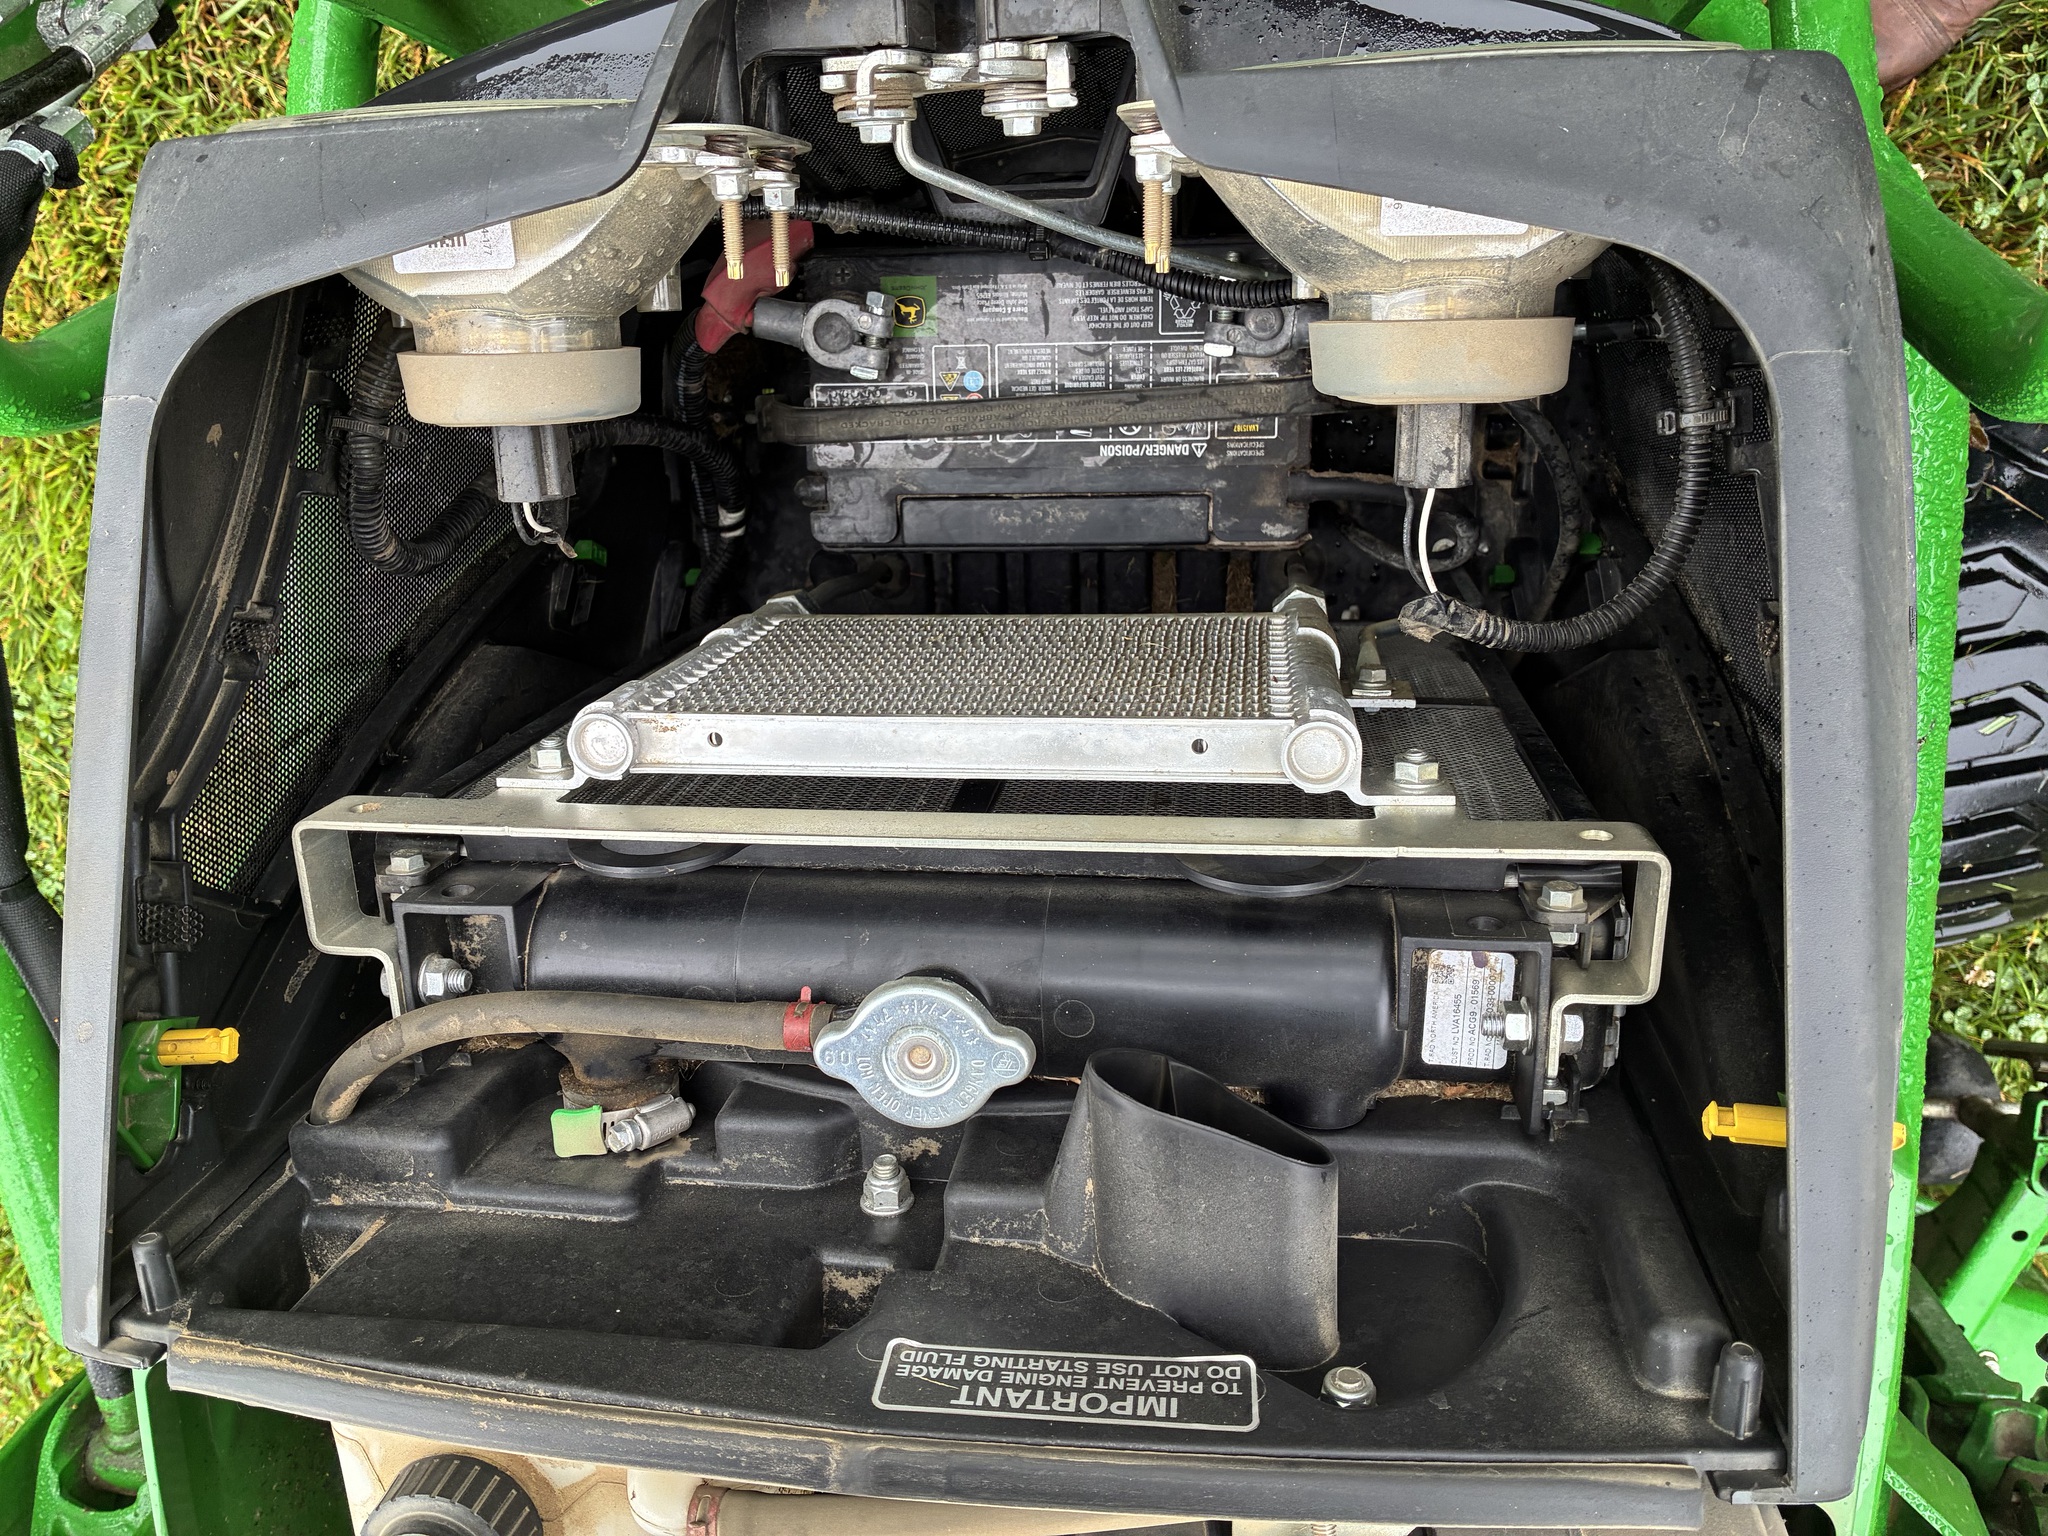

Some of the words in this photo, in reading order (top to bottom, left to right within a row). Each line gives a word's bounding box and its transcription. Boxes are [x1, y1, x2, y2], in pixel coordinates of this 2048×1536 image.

[982, 306, 1006, 314] Company
[840, 419, 890, 429] CRACKED
[895, 418, 910, 426] OR
[1100, 444, 1189, 456] DANGER/POISON
[1452, 994, 1462, 1034] LVA16455
[1469, 1036, 1476, 1047] NO
[1450, 1047, 1459, 1064] CUST
[857, 1056, 875, 1080] HOT
[868, 1082, 901, 1112] OPEN
[899, 1350, 967, 1366] FLUID
[974, 1354, 1090, 1374] STARTING
[895, 1364, 993, 1382] DAMAGE
[1096, 1362, 1144, 1376] USE
[1152, 1364, 1200, 1379] NOT
[1206, 1366, 1242, 1380] DO
[1000, 1371, 1088, 1388] ENGINE
[1094, 1376, 1204, 1395] PREVENT
[1211, 1380, 1243, 1395] TO
[950, 1385, 1178, 1418] IMPORTANT
